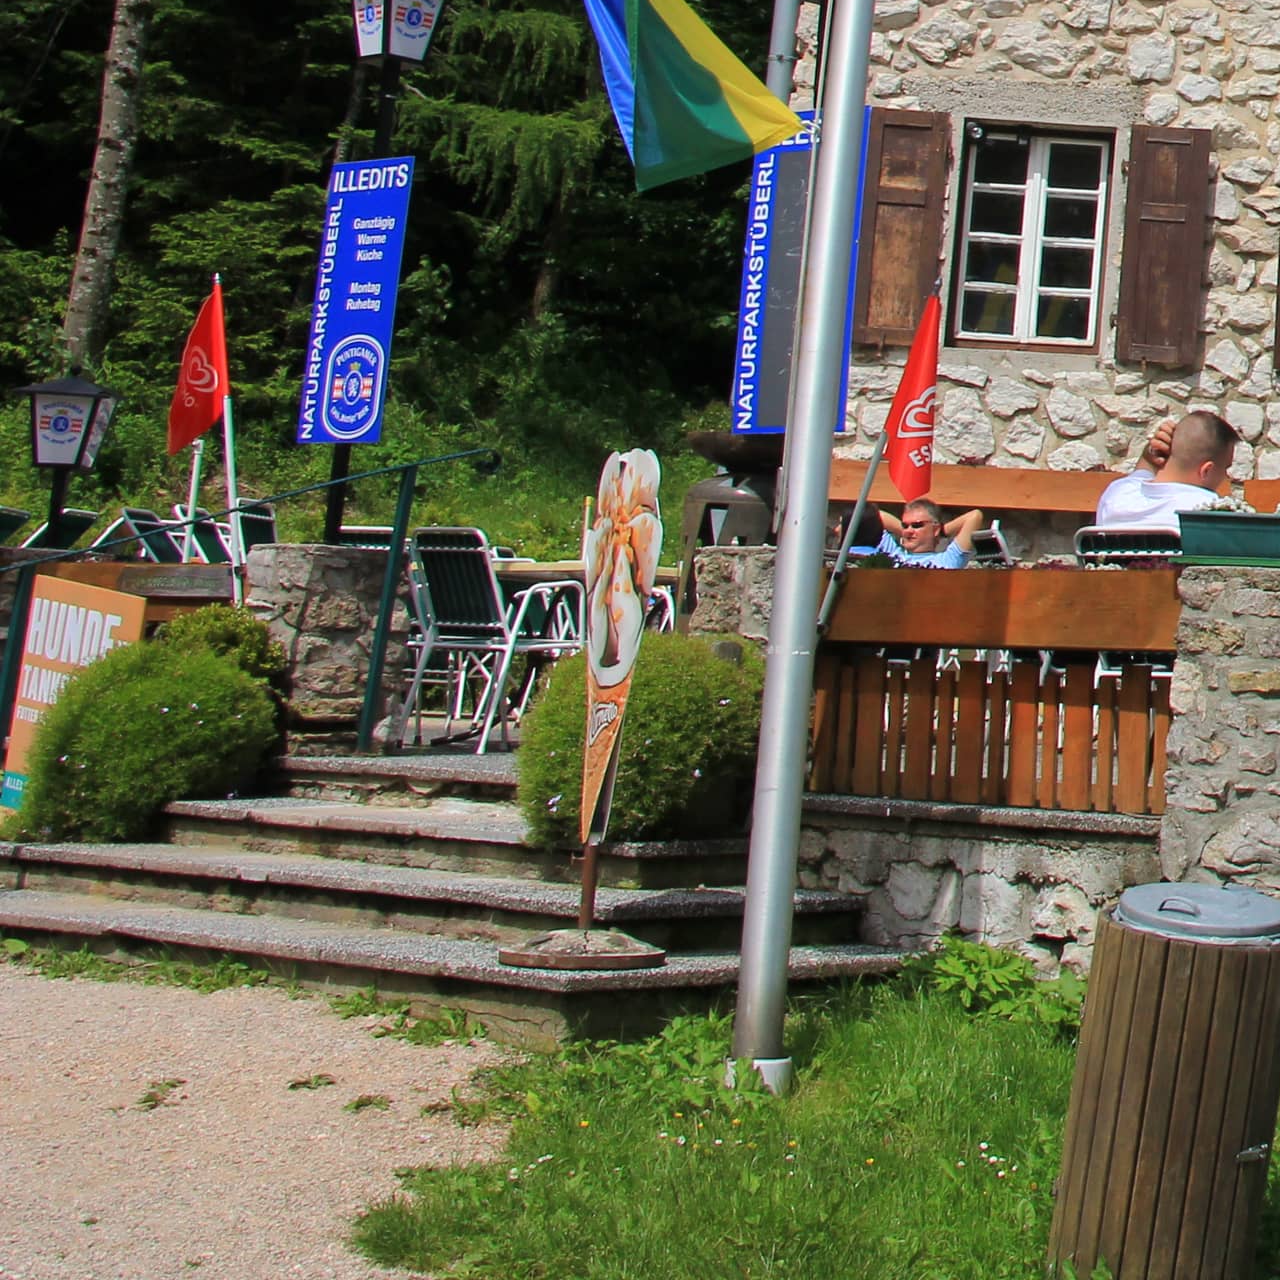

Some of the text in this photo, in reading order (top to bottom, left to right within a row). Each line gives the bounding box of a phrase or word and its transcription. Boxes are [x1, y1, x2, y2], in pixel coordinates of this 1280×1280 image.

[333, 163, 409, 193] ILLEDITS
[350, 282, 381, 296] Montag
[737, 153, 774, 429] NATURPARKSTÜBERL
[301, 198, 344, 439] NATURPARKSTÜBERL
[346, 298, 381, 312] Ruhetag
